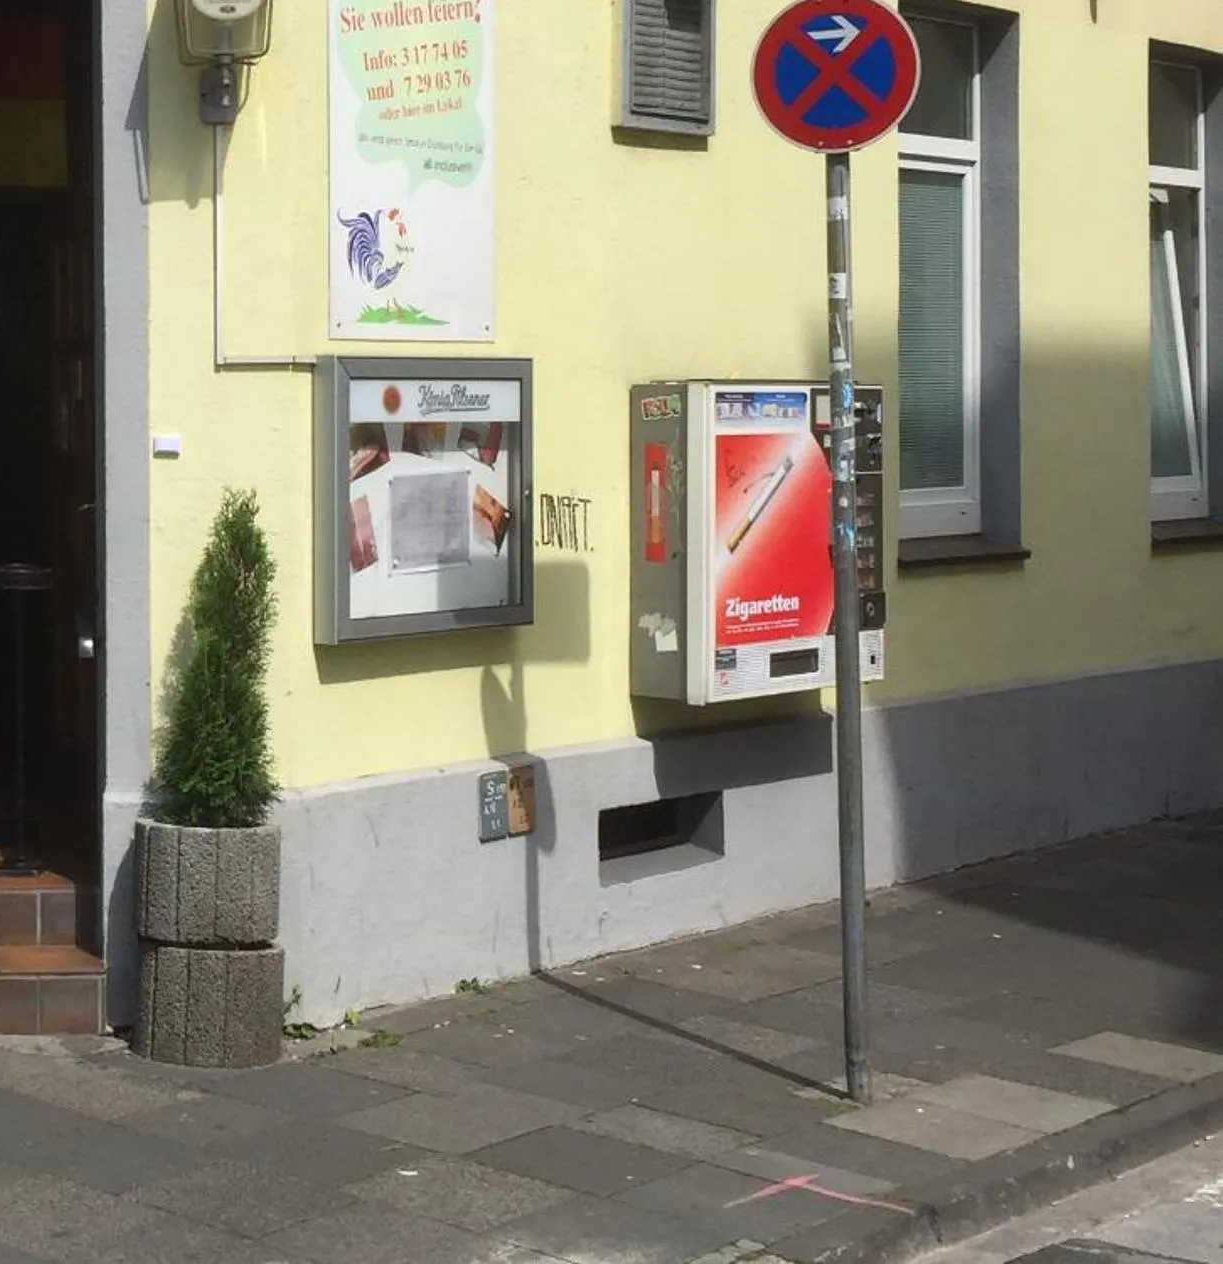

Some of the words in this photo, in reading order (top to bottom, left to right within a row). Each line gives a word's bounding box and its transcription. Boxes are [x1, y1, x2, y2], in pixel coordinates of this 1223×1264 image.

[340, 6, 366, 33] Sie
[371, 0, 424, 29] wollen
[363, 49, 398, 71] Info:
[401, 46, 411, 67] 3
[414, 44, 428, 65] 17
[432, 42, 448, 62] 74
[452, 40, 468, 59] 05
[366, 78, 394, 101] und
[404, 75, 412, 96] 7
[417, 73, 432, 94] 29
[435, 71, 451, 91] 03
[455, 69, 471, 89] 76
[726, 594, 800, 621] Zigaretten
